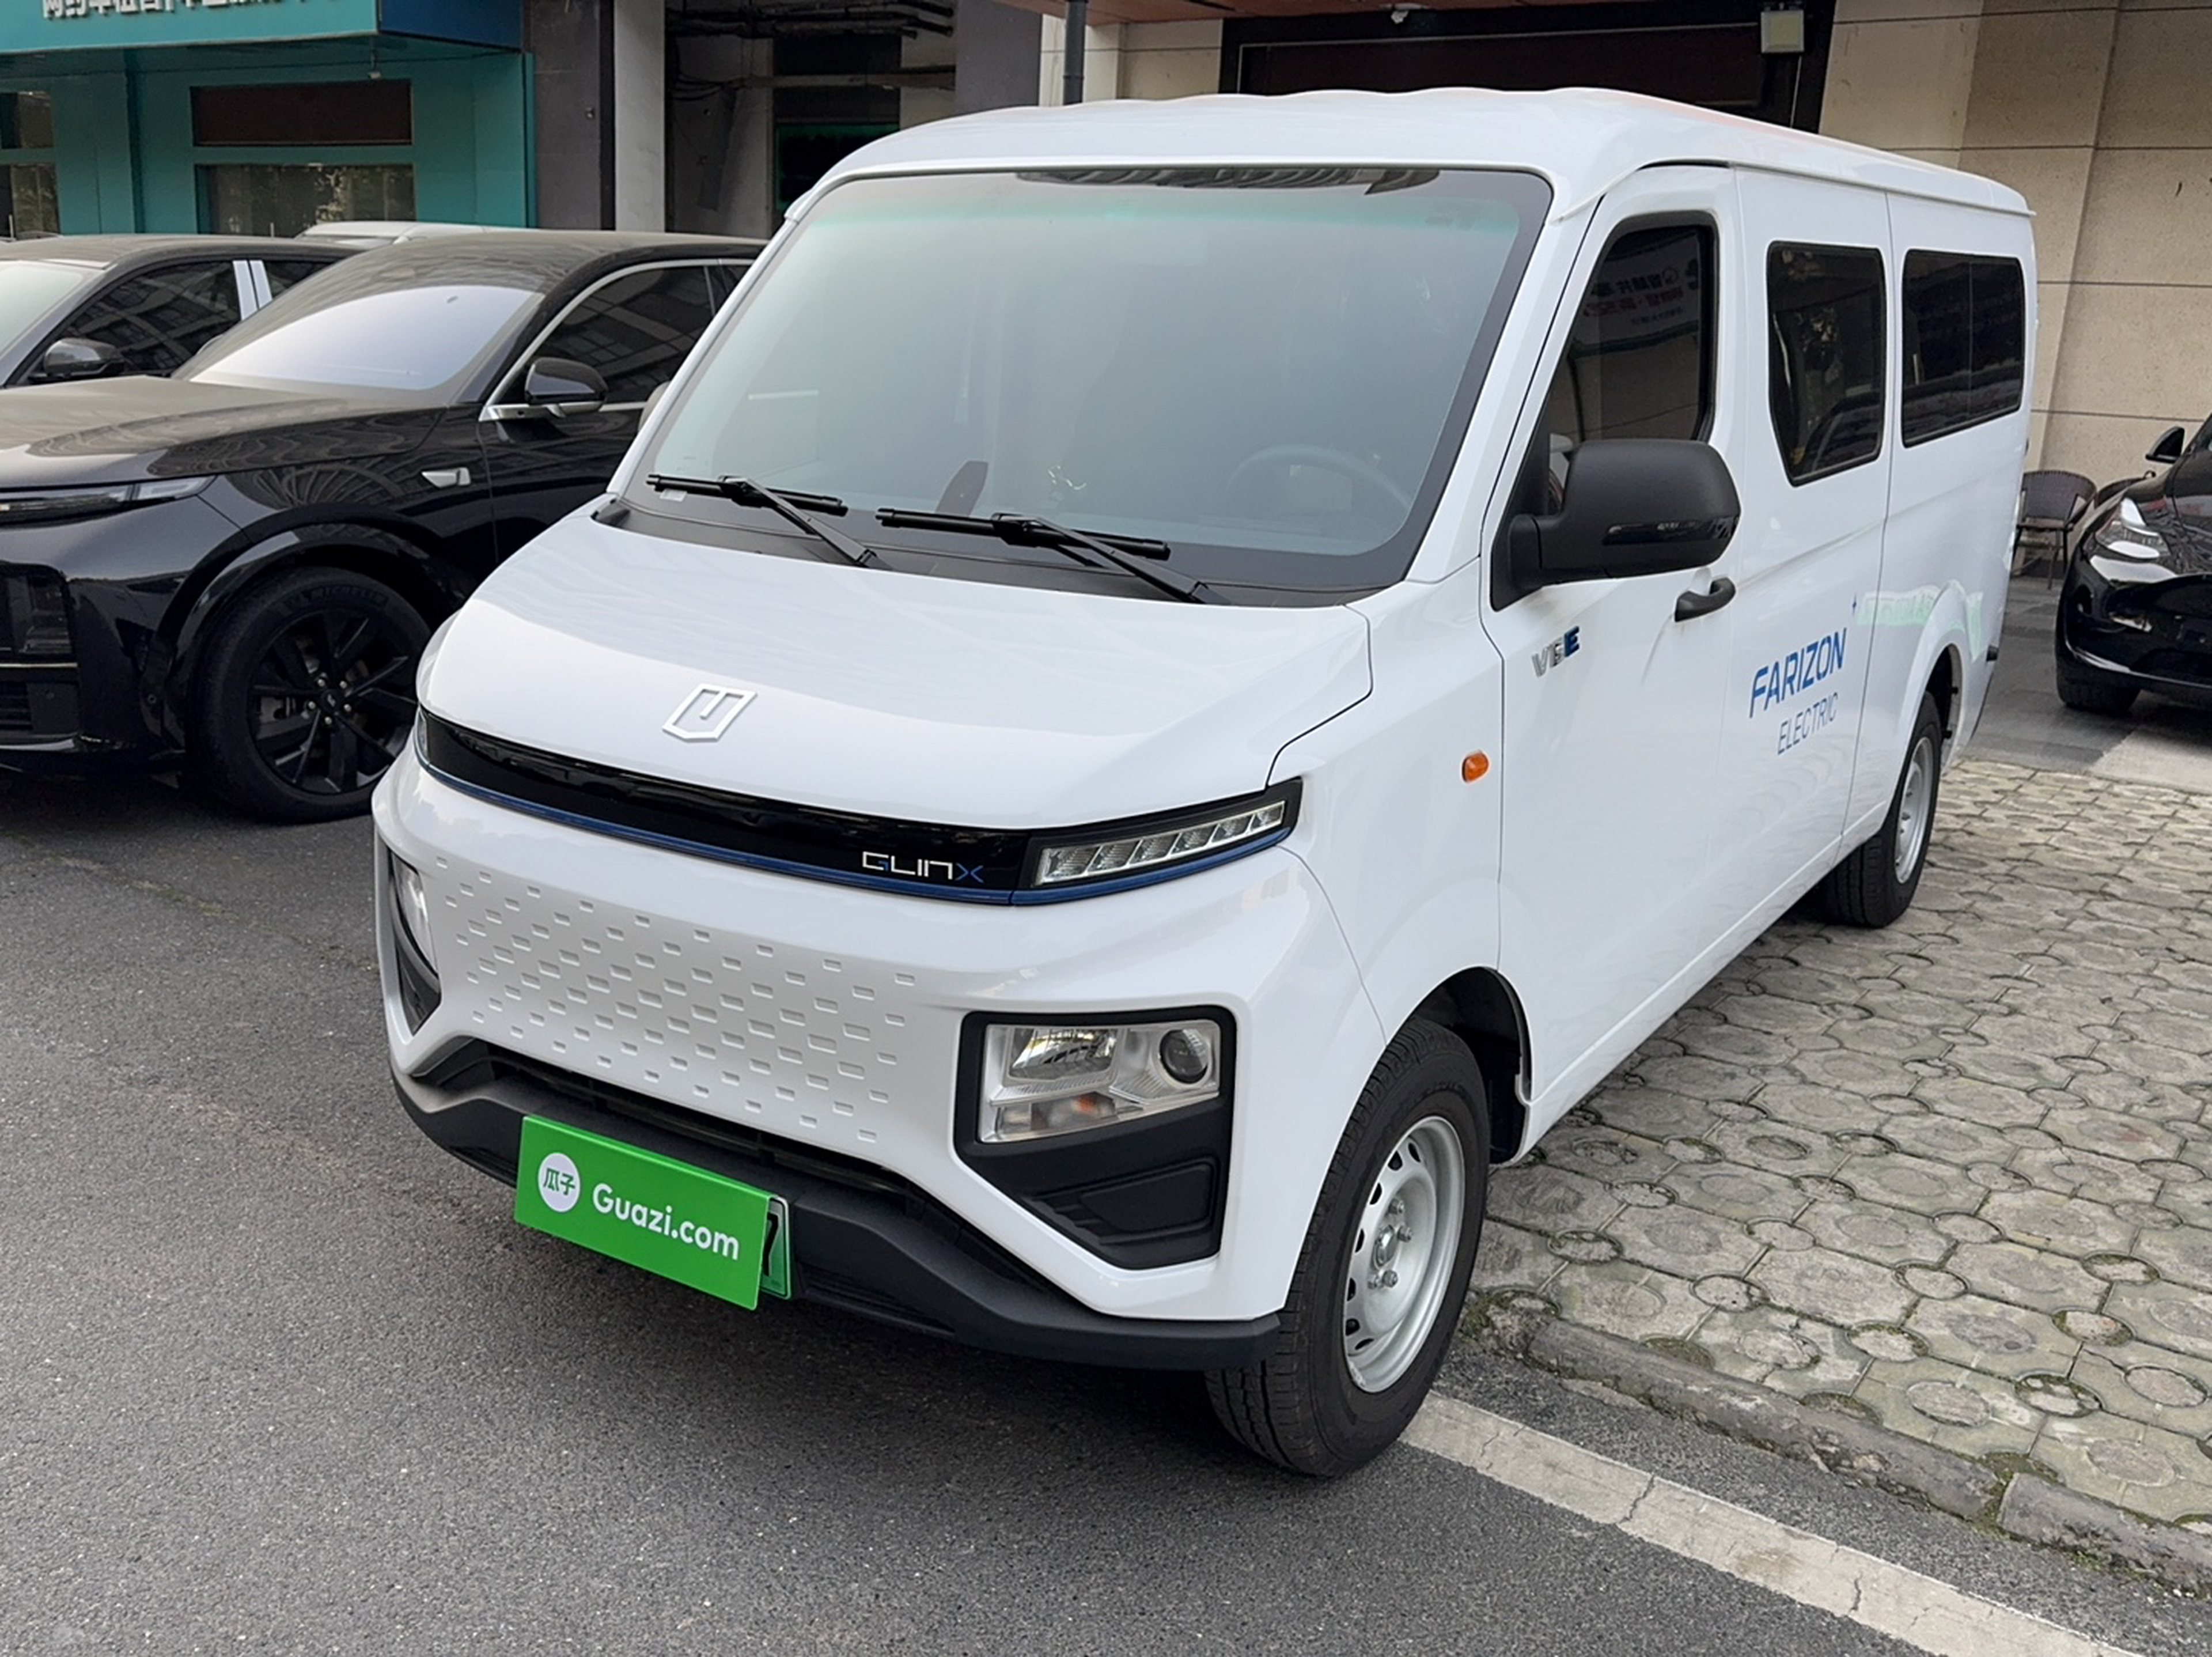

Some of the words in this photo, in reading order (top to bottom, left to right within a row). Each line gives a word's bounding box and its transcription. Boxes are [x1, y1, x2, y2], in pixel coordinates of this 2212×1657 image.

[1749, 627, 1847, 718] FARIZON
[1778, 692, 1838, 755] ELECTRIC
[543, 1167, 575, 1196] 瓜子
[593, 1183, 739, 1260] Guazi.com
